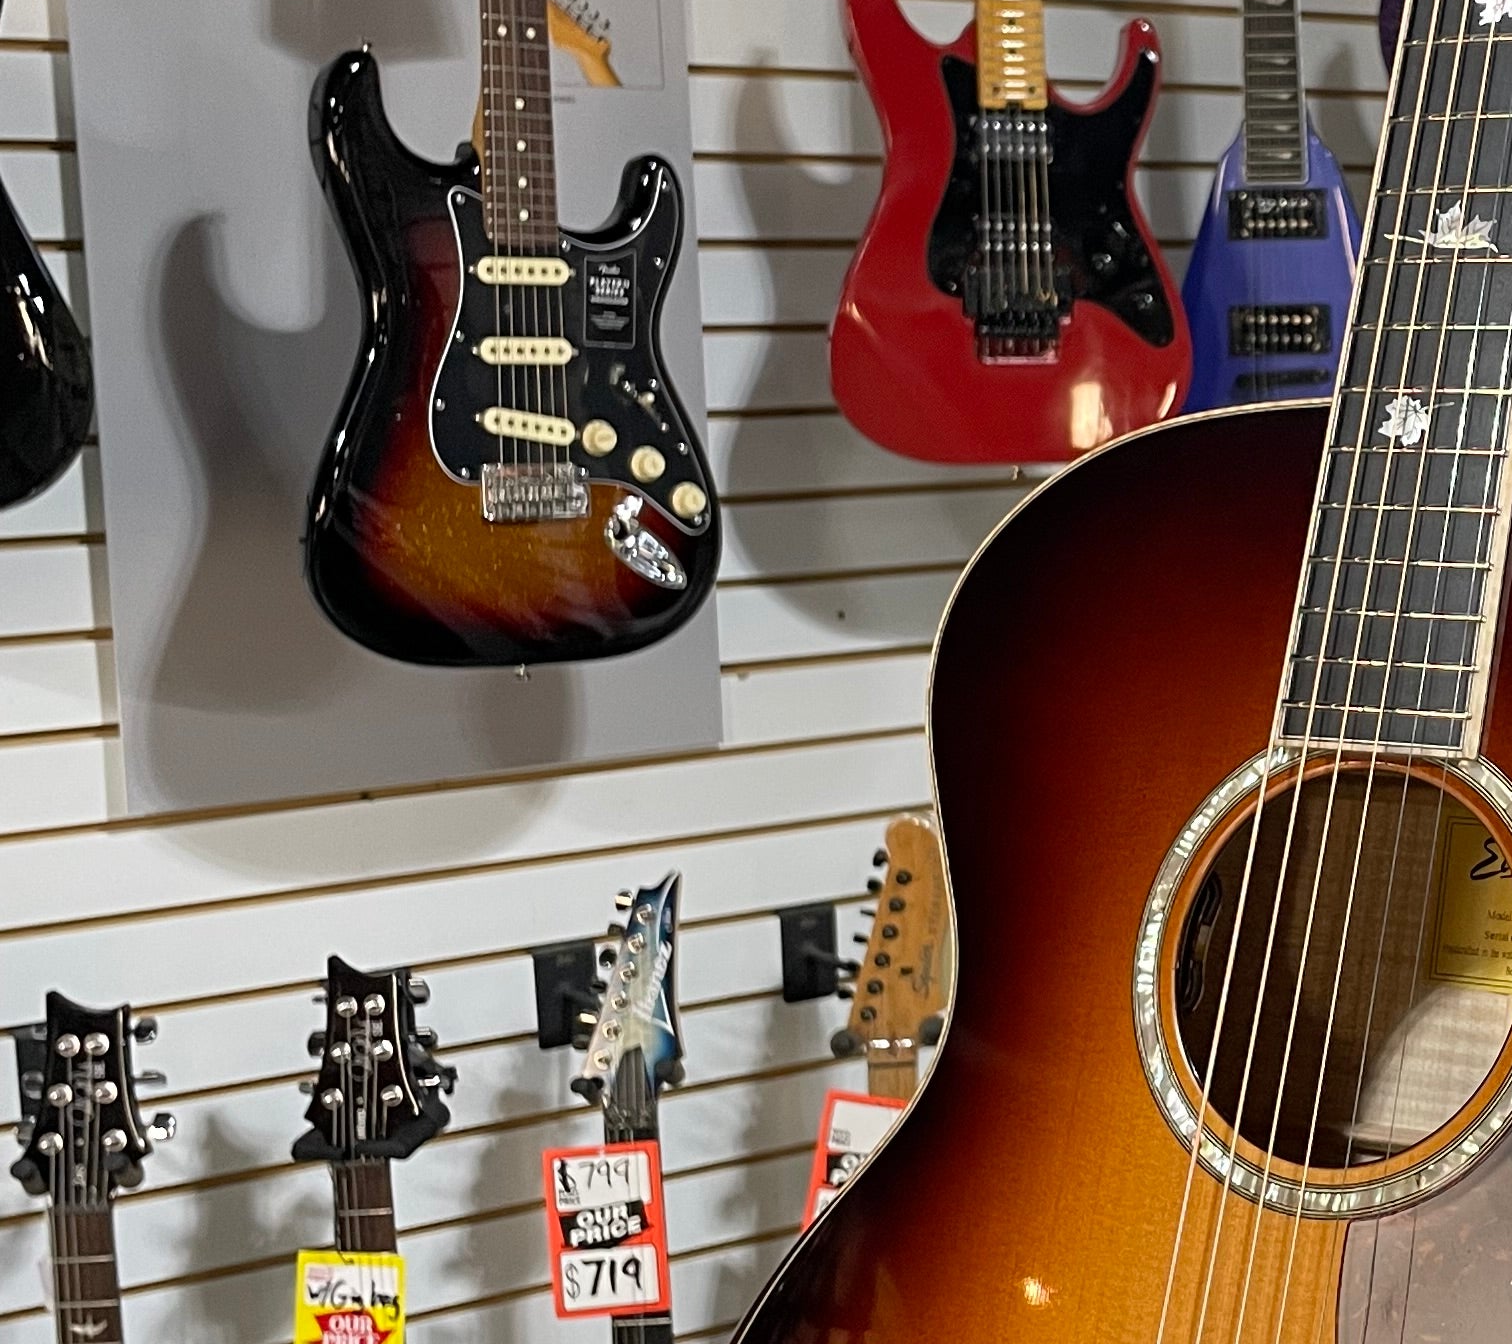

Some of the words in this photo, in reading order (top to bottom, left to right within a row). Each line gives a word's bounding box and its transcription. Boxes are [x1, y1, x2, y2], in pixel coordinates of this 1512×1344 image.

[576, 1201, 628, 1228] OUR
[570, 1214, 642, 1248] PRICE
[565, 1255, 642, 1301] $719
[328, 1314, 373, 1334] OUR
